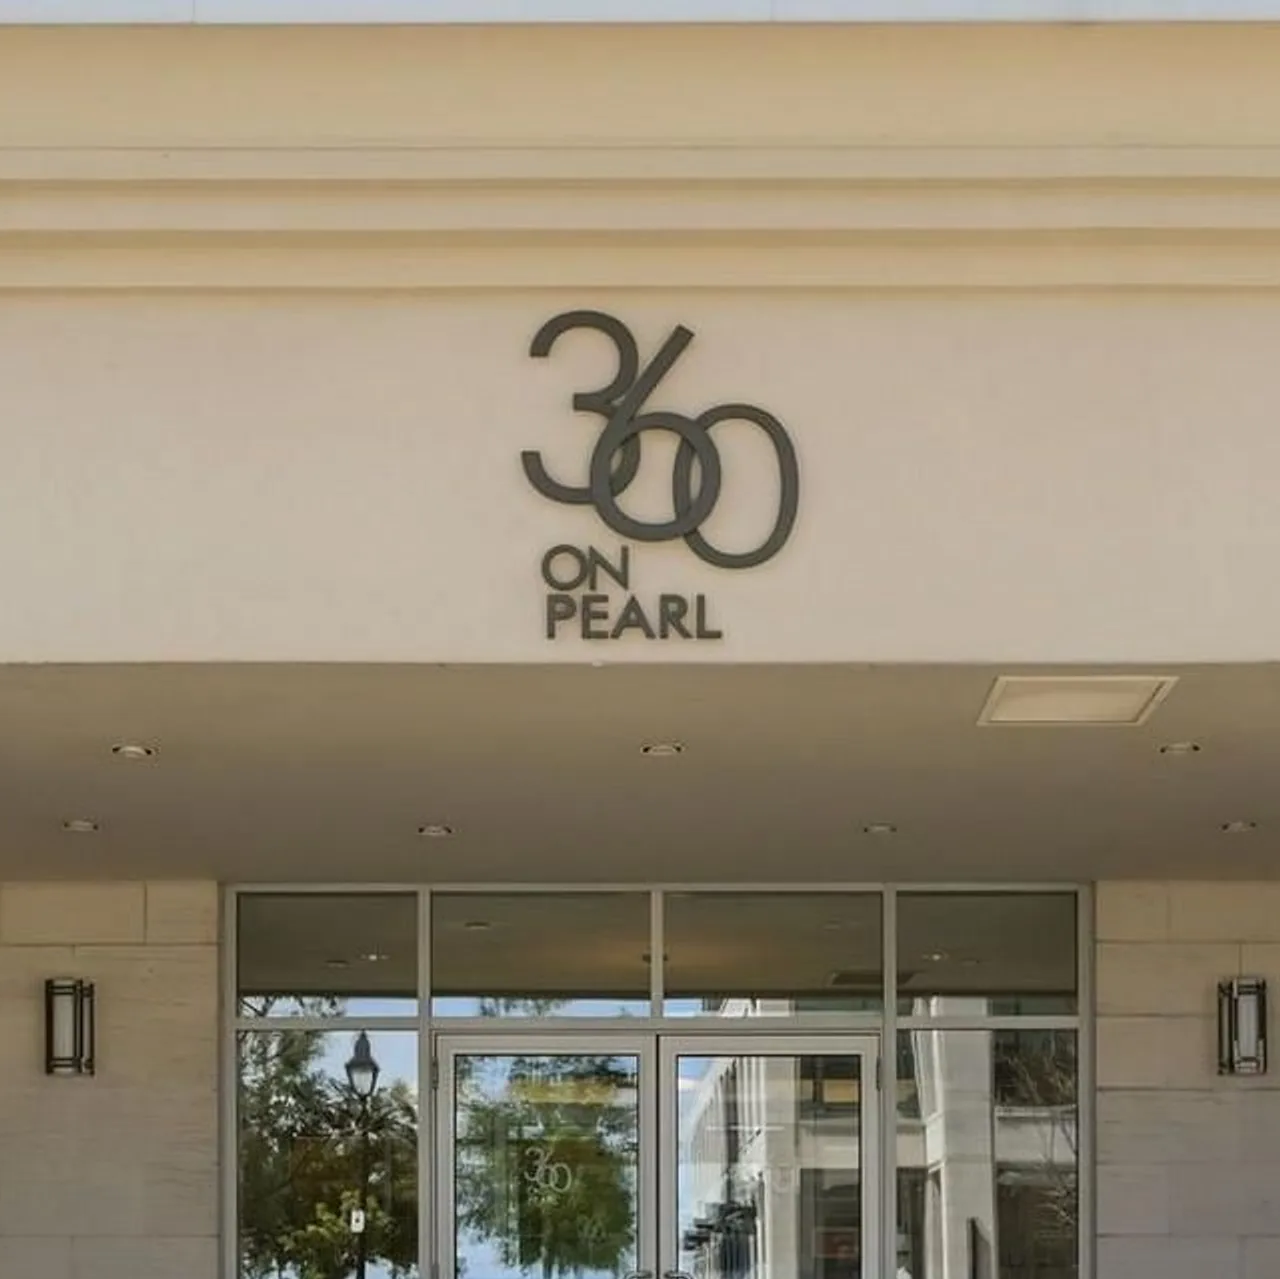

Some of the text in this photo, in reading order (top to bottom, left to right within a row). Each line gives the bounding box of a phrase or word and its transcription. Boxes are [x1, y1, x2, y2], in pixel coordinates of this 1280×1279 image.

[521, 310, 799, 569] 360
[541, 544, 629, 591] ON
[546, 594, 723, 640] PEARL
[524, 1146, 572, 1193] 360
